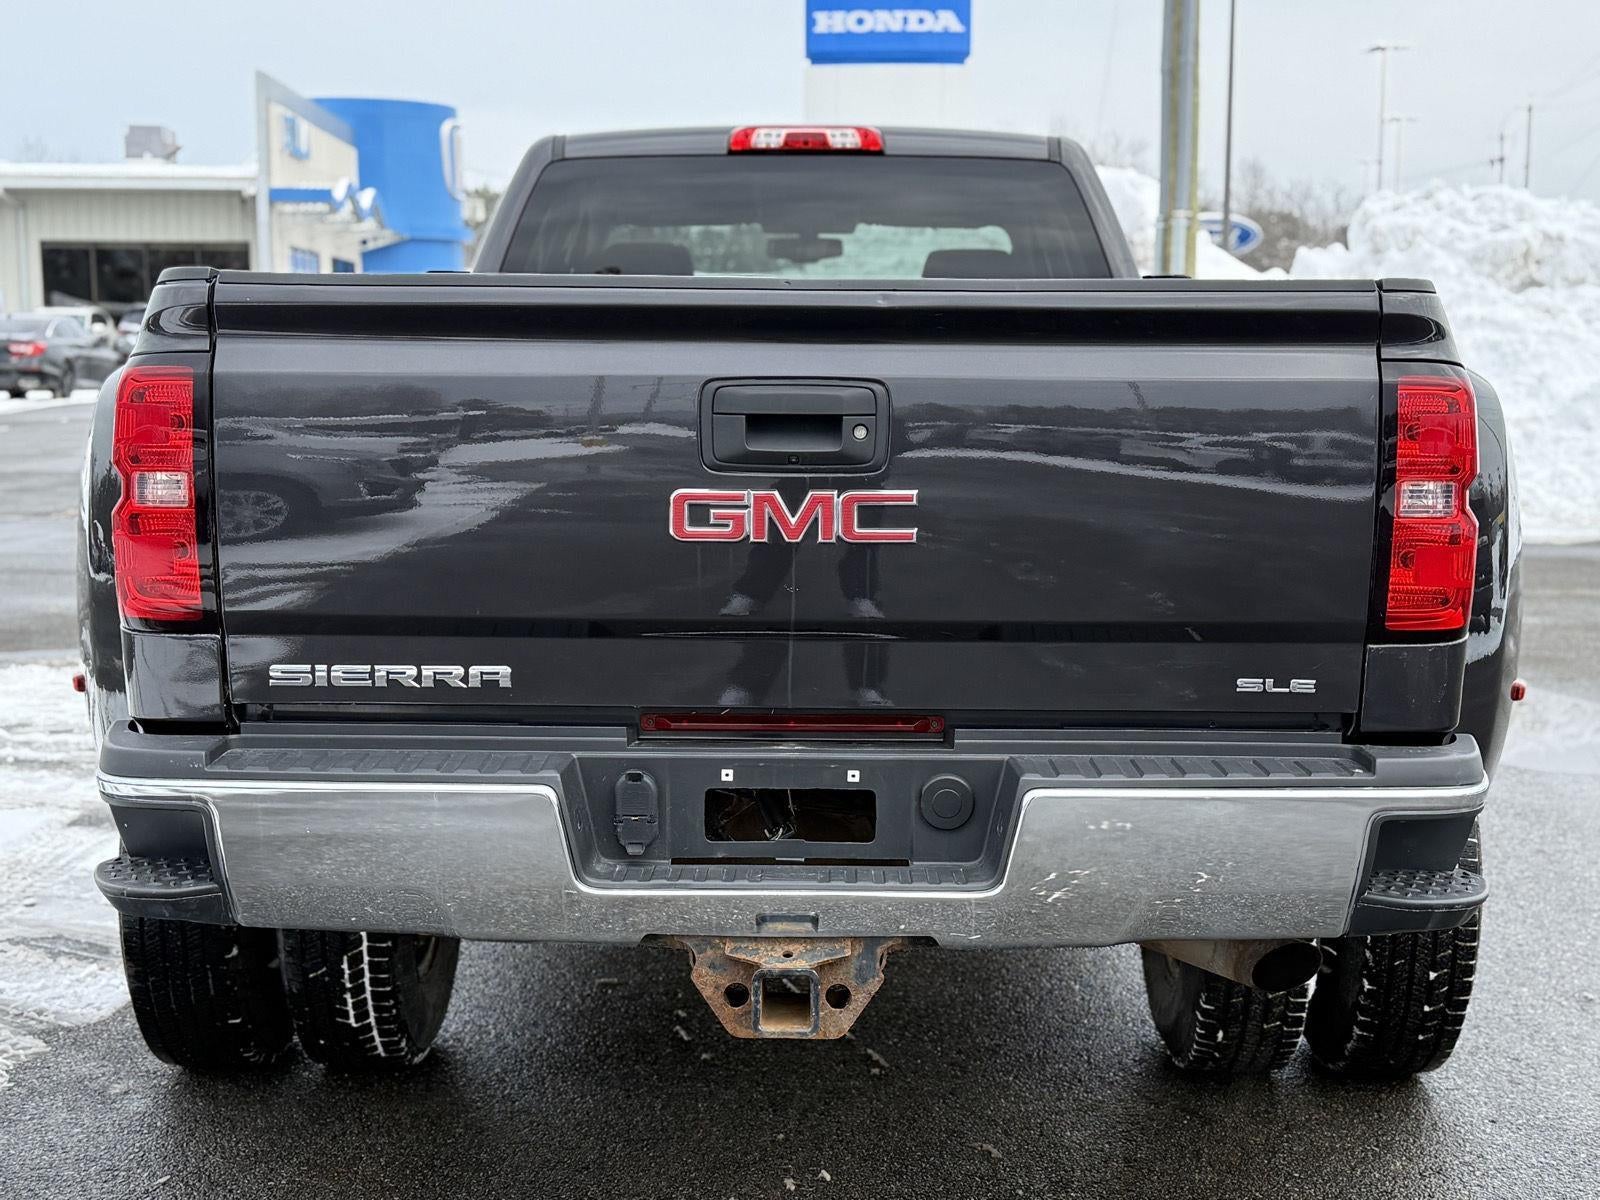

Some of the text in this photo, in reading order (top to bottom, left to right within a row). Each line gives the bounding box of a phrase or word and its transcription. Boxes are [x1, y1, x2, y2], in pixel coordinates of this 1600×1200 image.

[812, 9, 966, 33] HONDA
[669, 488, 918, 544] GMC
[269, 664, 512, 688] SIERRA
[1236, 678, 1317, 693] SLE
